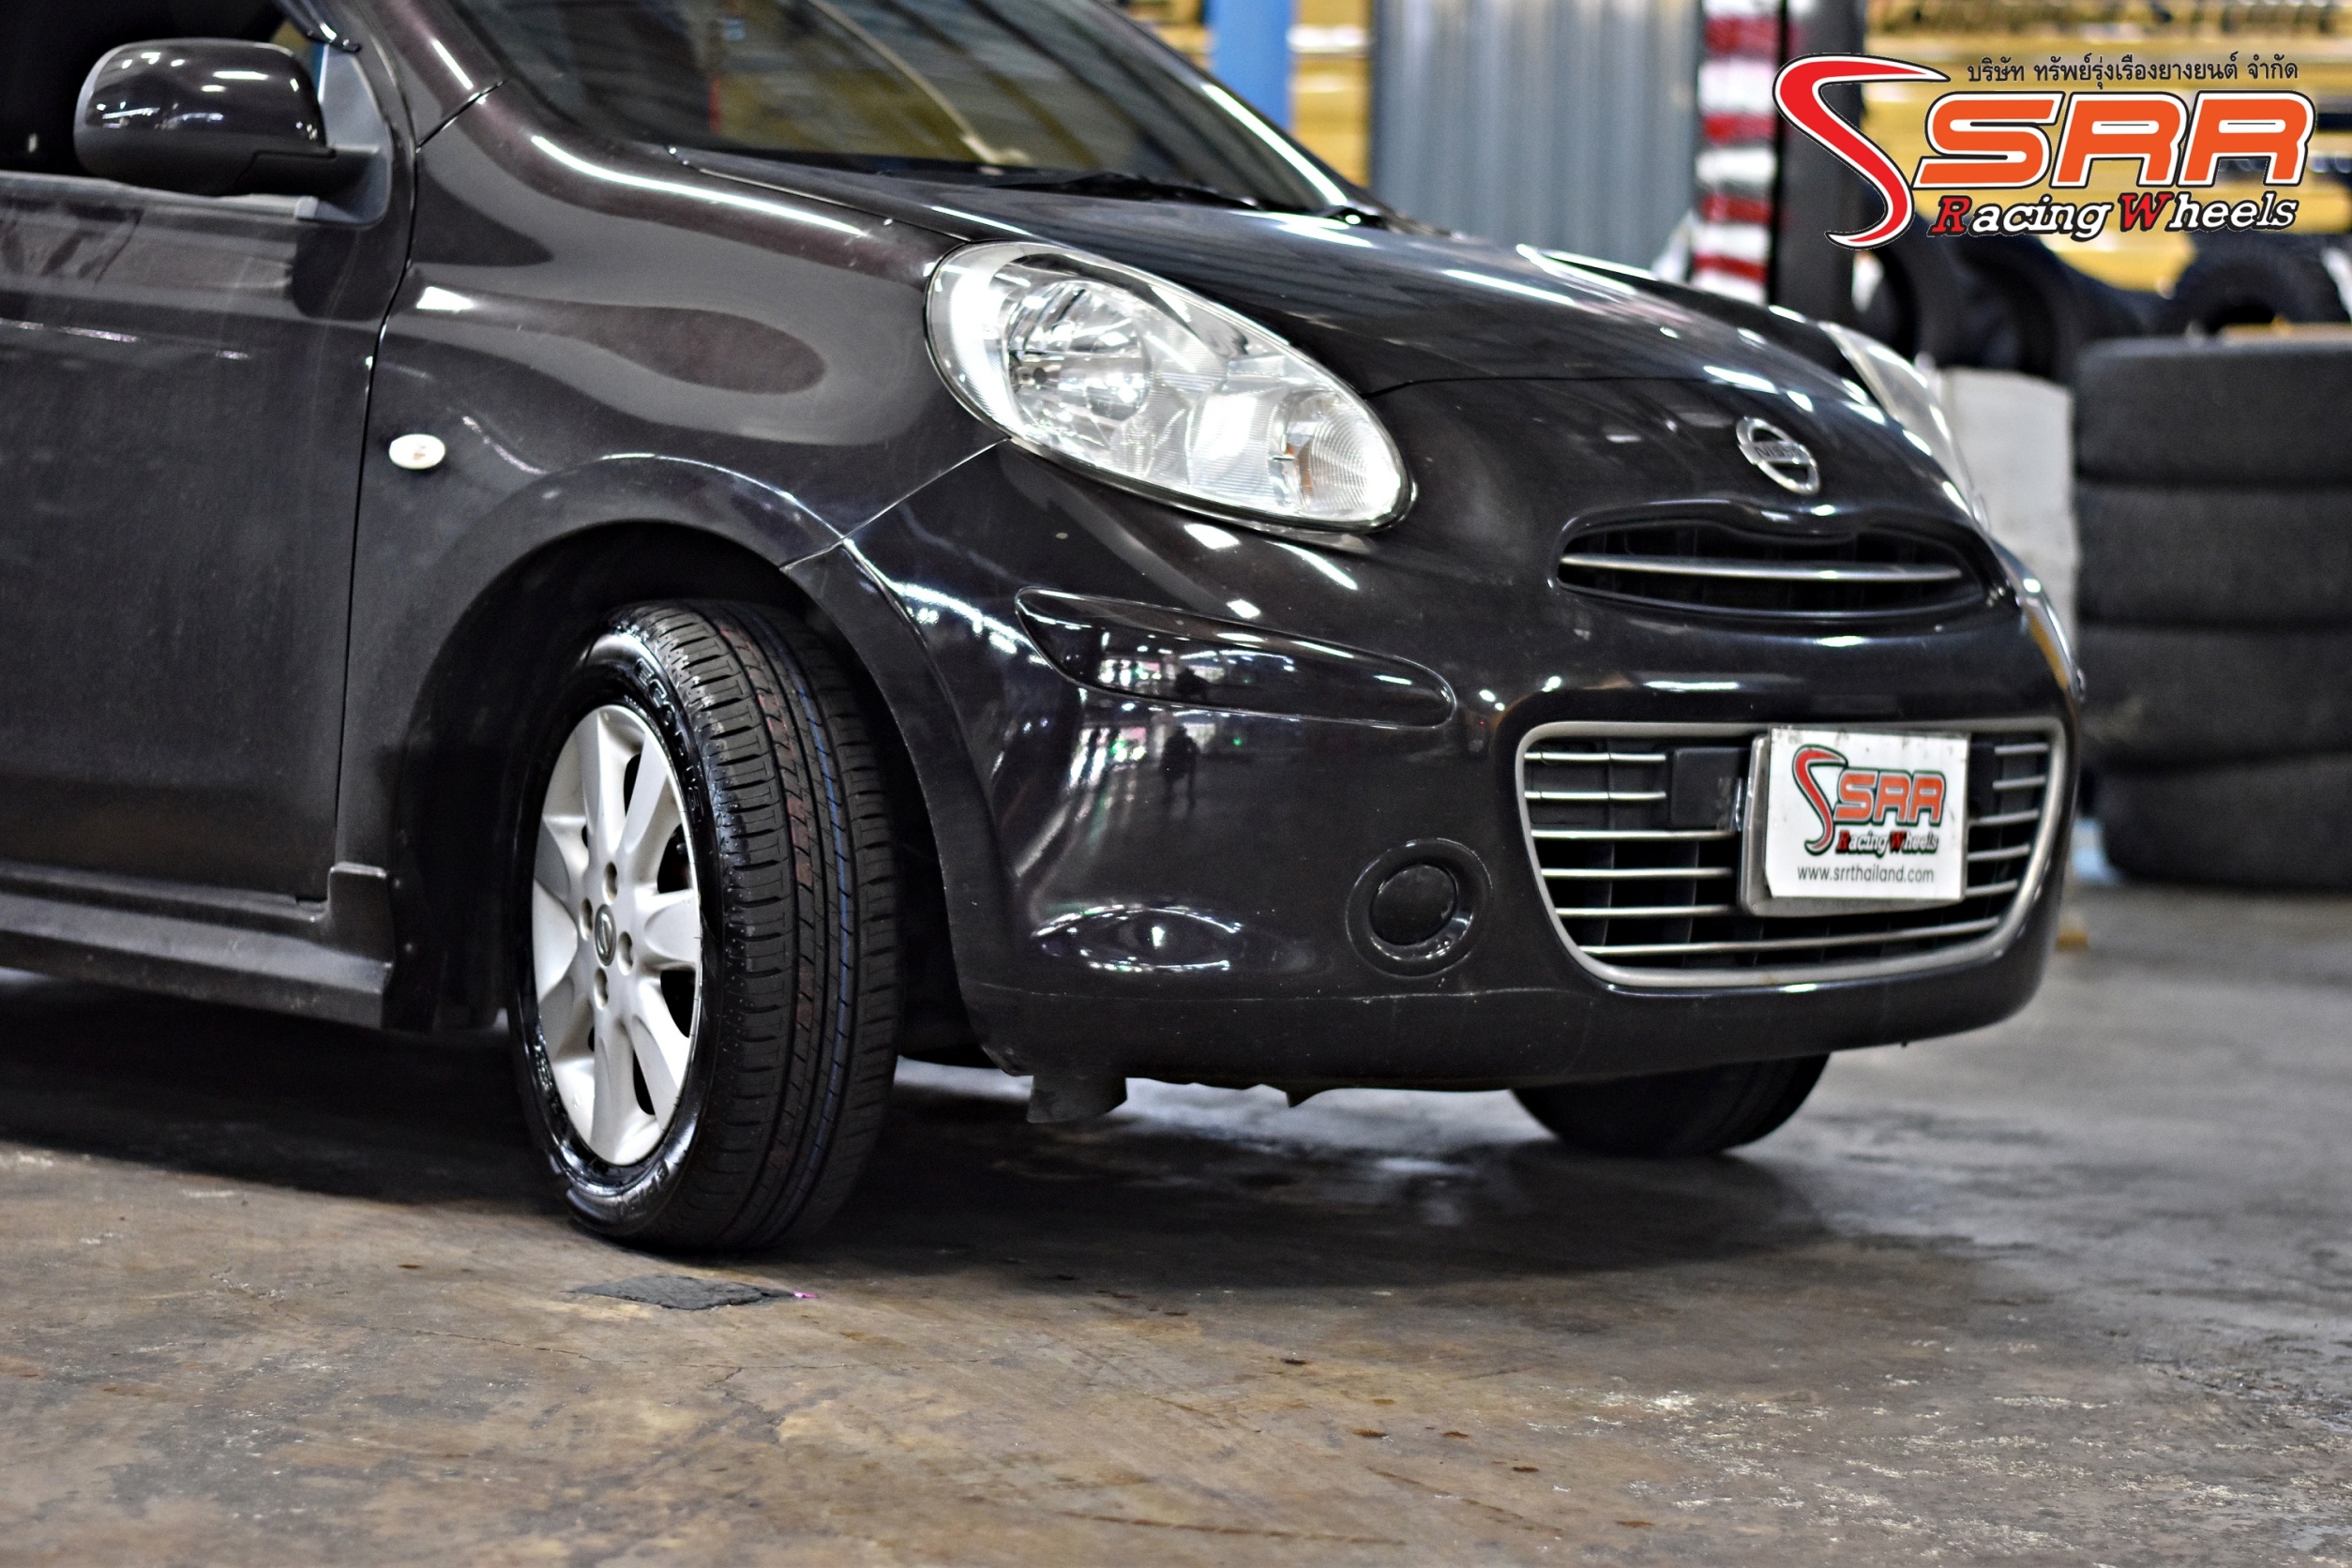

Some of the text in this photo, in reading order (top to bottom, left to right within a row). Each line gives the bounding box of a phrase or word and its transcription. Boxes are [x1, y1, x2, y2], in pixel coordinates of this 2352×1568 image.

[1833, 765, 1947, 827] SRR
[1835, 829, 1940, 858] Racing Wheels
[1797, 864, 1935, 883] www.srrthailand.com
